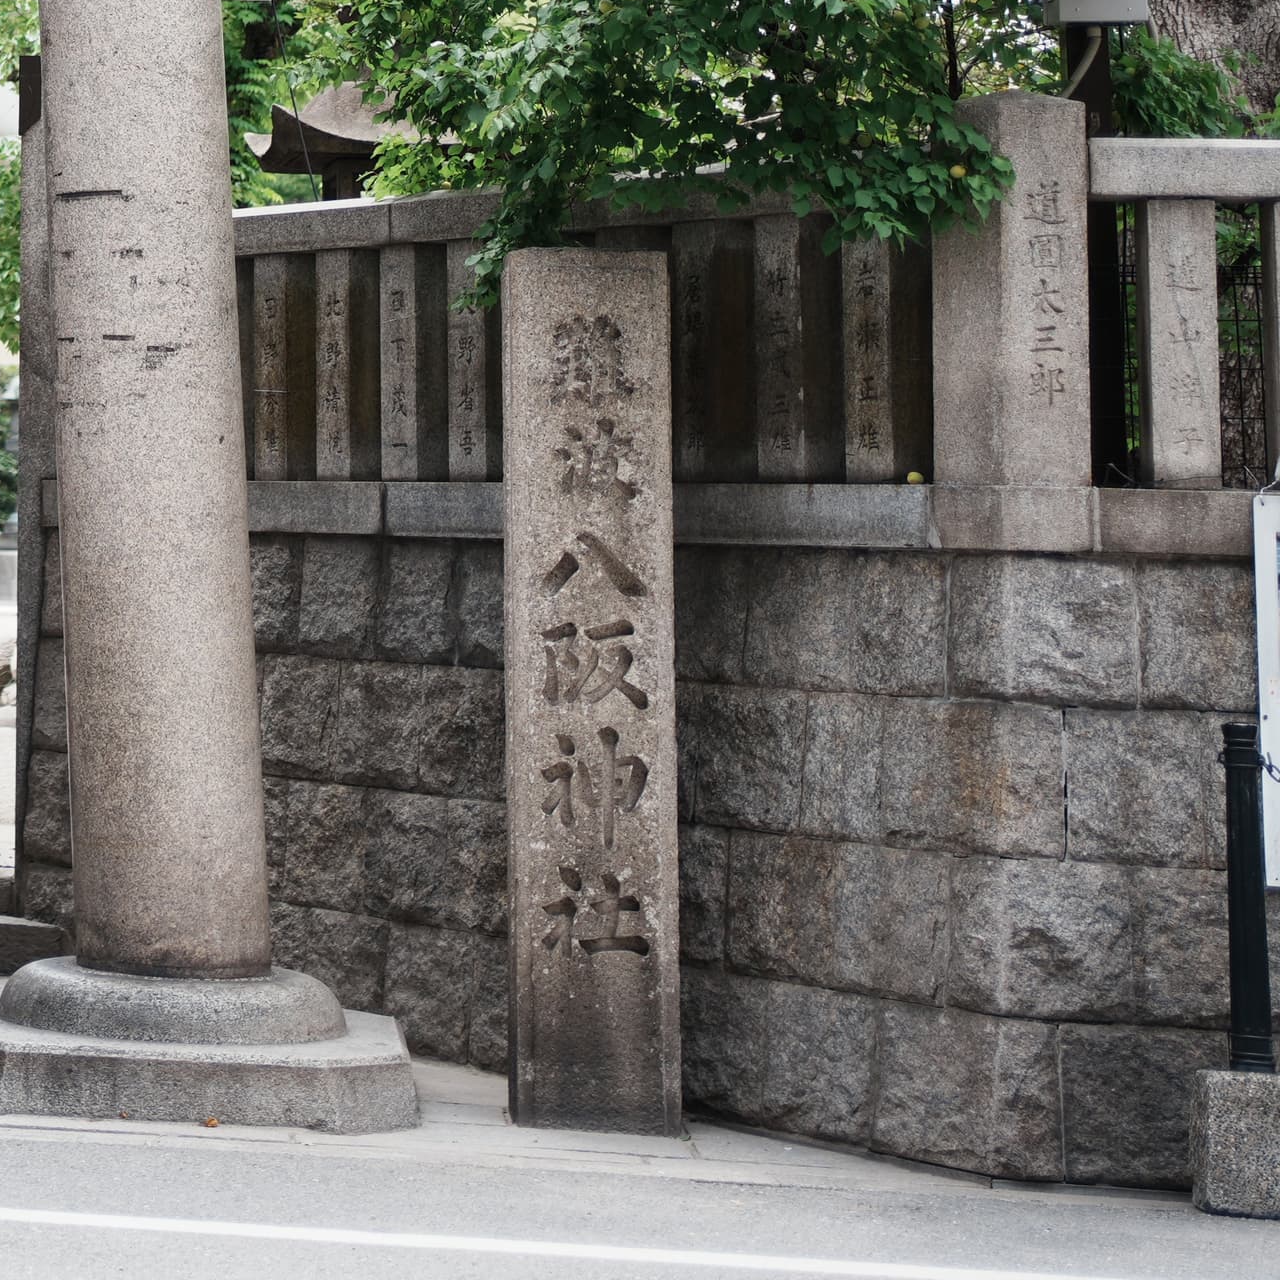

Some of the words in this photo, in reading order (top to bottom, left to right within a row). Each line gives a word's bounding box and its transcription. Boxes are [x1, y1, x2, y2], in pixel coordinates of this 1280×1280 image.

[542, 316, 649, 959] 難波八阪神社
